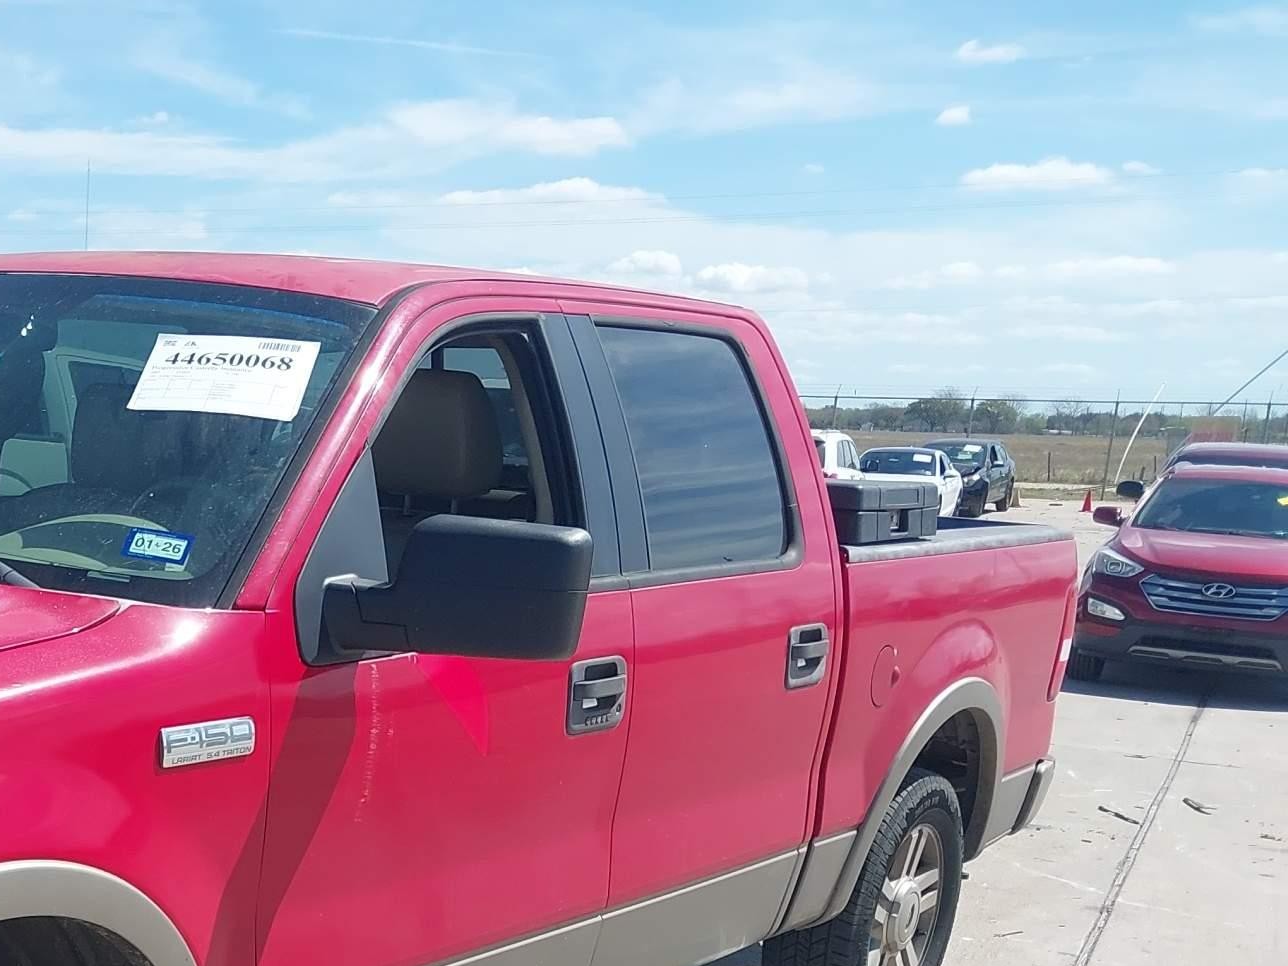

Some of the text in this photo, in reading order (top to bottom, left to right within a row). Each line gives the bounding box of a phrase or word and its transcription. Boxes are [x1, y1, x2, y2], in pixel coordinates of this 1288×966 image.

[165, 351, 294, 372] 44650068
[173, 754, 202, 764] LARIAT
[222, 746, 252, 757] TRITON
